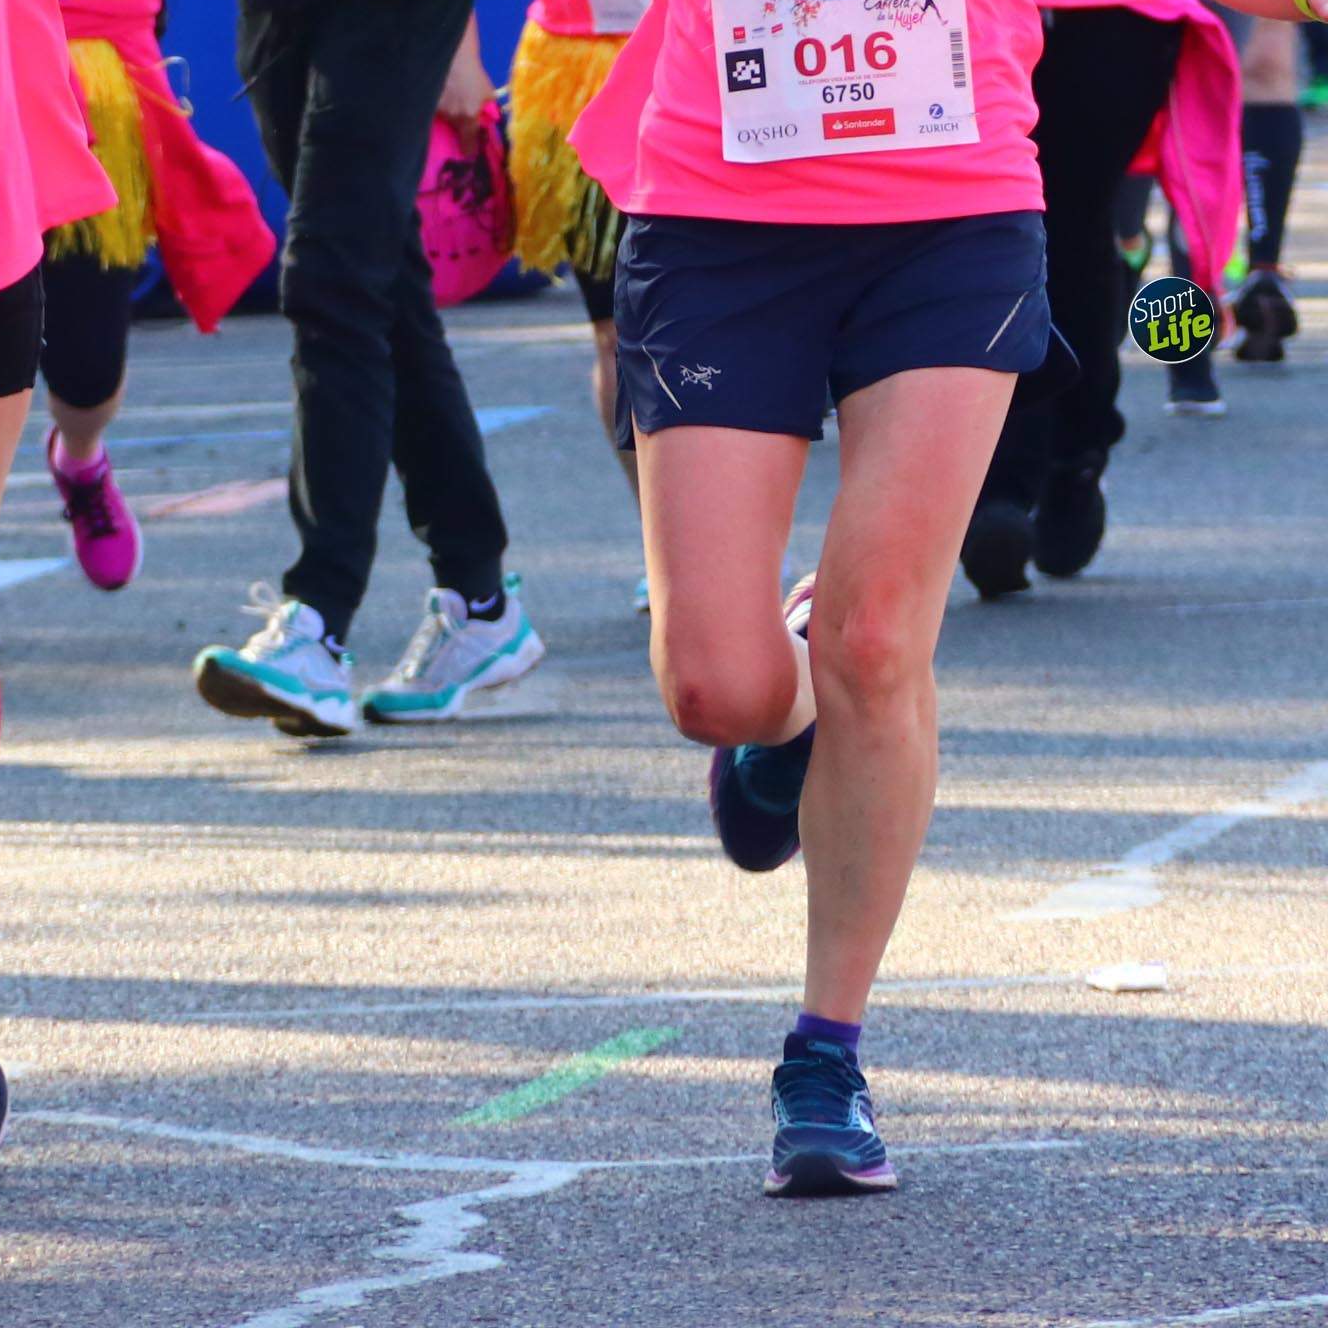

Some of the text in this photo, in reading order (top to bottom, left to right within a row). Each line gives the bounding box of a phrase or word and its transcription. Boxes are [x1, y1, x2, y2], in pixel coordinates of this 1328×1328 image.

[893, 9, 926, 31] Mujer
[794, 31, 897, 77] 016
[823, 82, 875, 103] 6750
[737, 124, 798, 143] OYSHO
[843, 118, 887, 130] Santander
[919, 123, 960, 134] ZURICH
